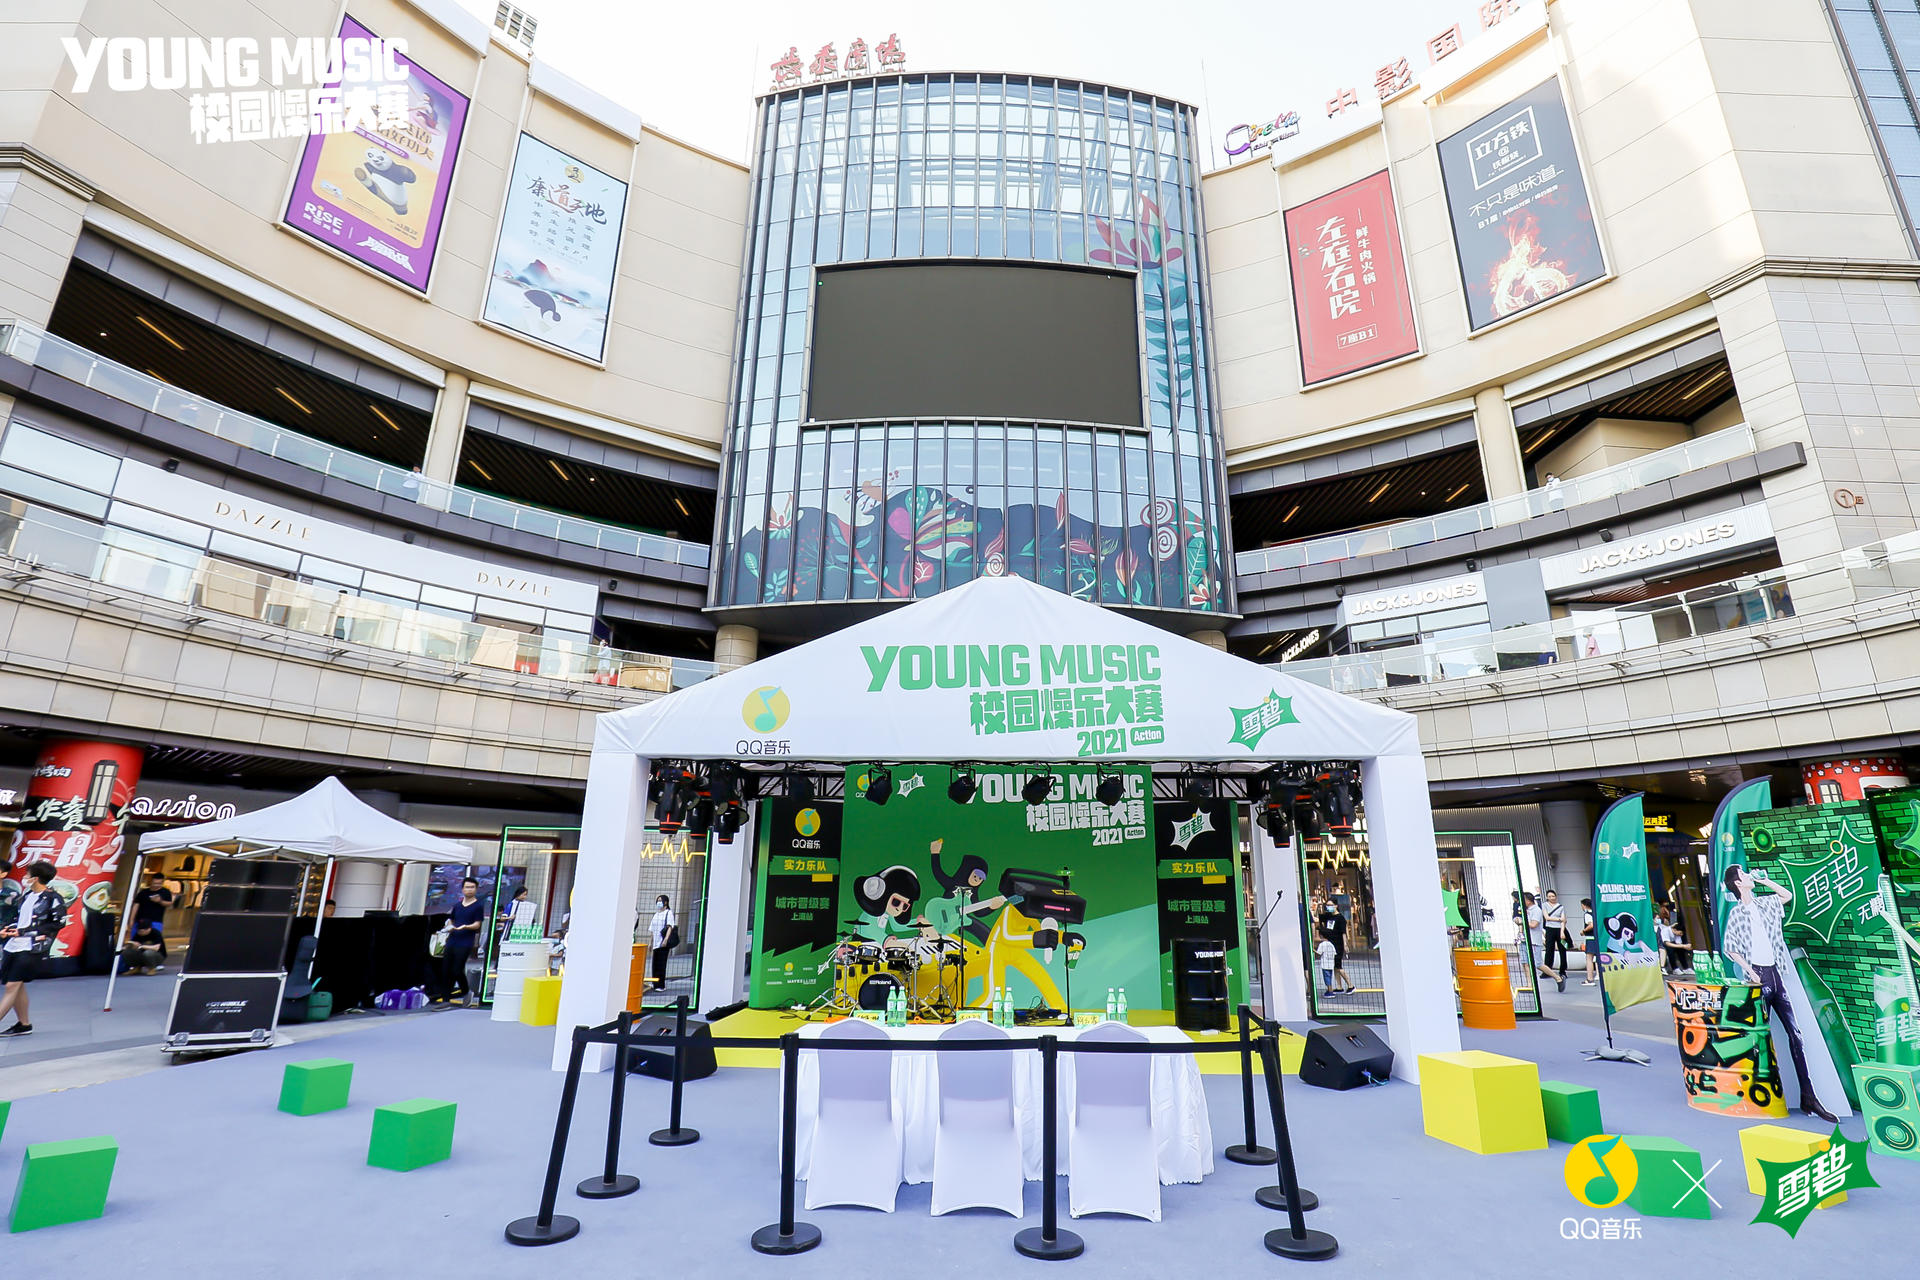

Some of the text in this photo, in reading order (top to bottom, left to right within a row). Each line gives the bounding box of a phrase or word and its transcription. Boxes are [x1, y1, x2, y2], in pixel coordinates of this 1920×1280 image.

[1474, 121, 1530, 160] 立方铁
[1355, 226, 1377, 285] 鲜牛肉火锅
[215, 501, 313, 541] DAZZLE
[1578, 521, 1737, 574] JACK&JONES
[477, 571, 553, 597] DAZZLE
[1352, 581, 1478, 616] JACK&JONES
[1280, 629, 1320, 663] JACK&JONES
[860, 645, 1161, 692] YOUNG MUSIC
[970, 684, 1164, 736] 校园燥乐大赛
[1239, 697, 1284, 740] 雪碧
[736, 739, 791, 756] QQ音乐
[1077, 728, 1128, 757] 2021
[1027, 800, 1145, 832] 校园燥乐大赛
[1178, 814, 1205, 842] 雪碧
[792, 839, 821, 849] QQ音乐
[1092, 828, 1123, 846] 2021
[784, 859, 827, 871] 实力乐队
[1171, 862, 1218, 874] 实力乐队
[1802, 844, 1869, 920] 雪碧
